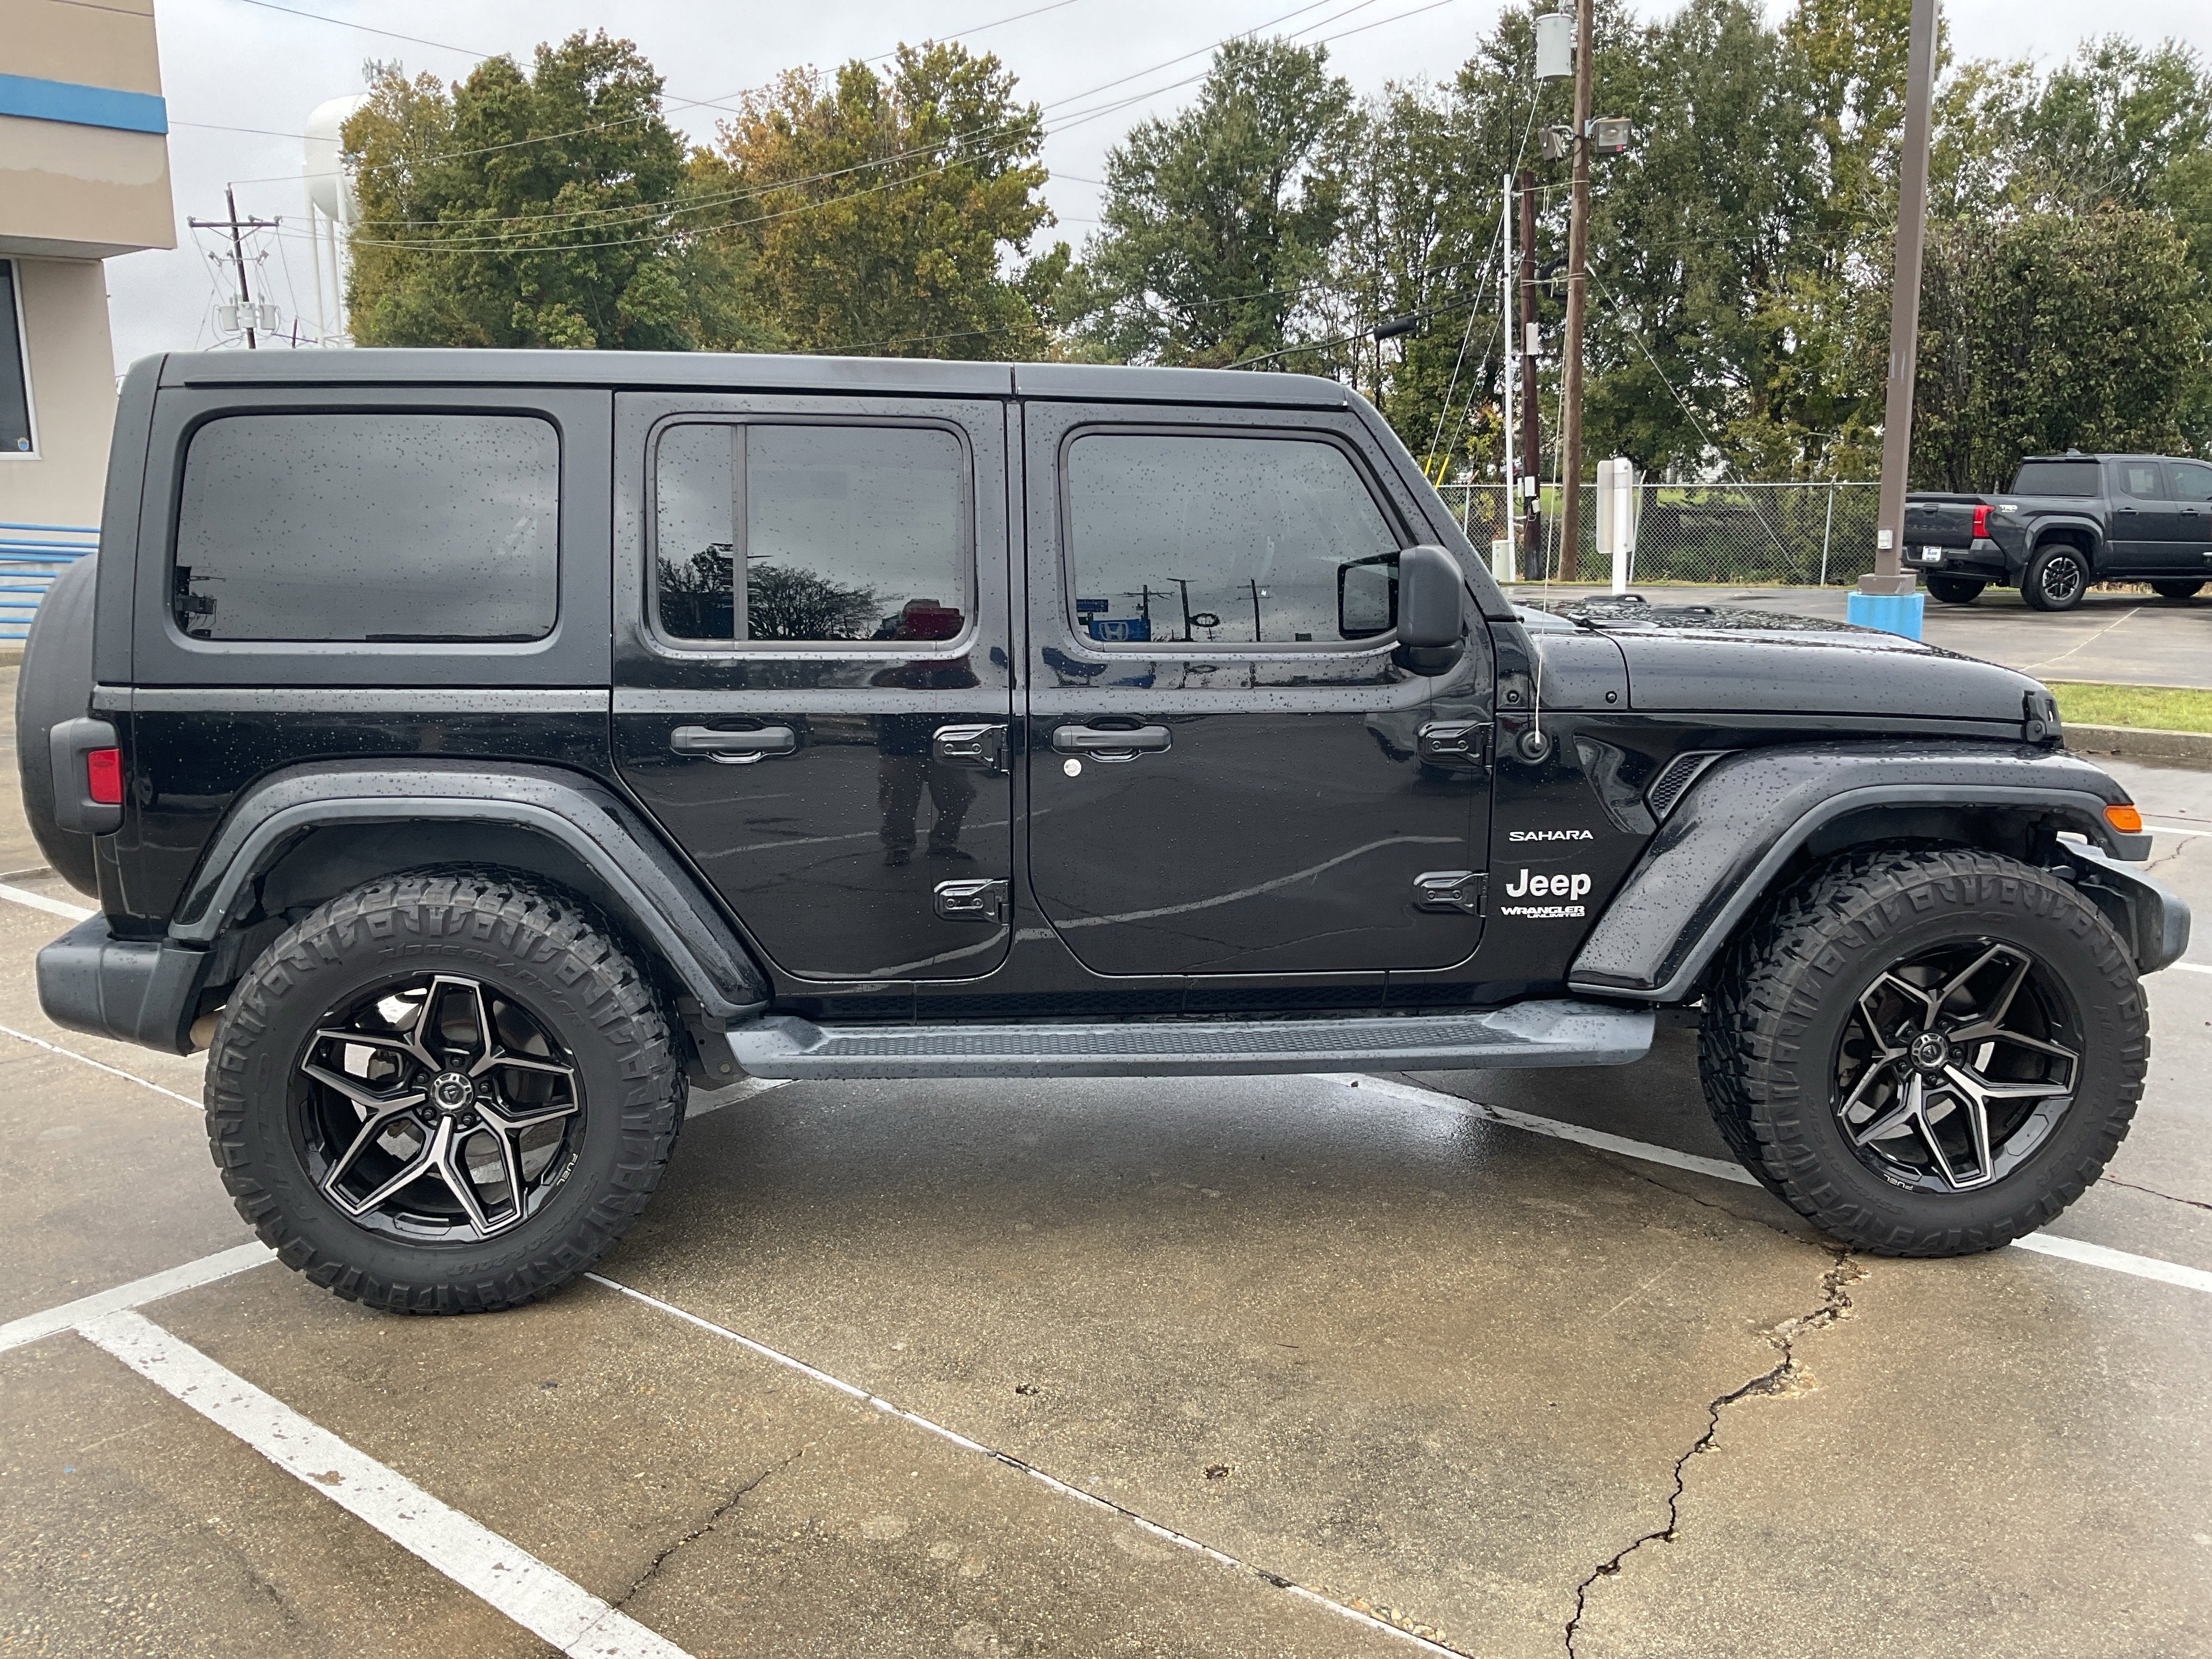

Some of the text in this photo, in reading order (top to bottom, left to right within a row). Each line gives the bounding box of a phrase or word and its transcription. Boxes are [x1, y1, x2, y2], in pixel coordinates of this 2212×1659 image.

[1509, 830, 1594, 842] SAHARA
[1505, 868, 1591, 900] Jeep
[1500, 906, 1585, 915] WRANGLER
[556, 1153, 578, 1187] FUEL
[1883, 1173, 1914, 1190] FUEL
